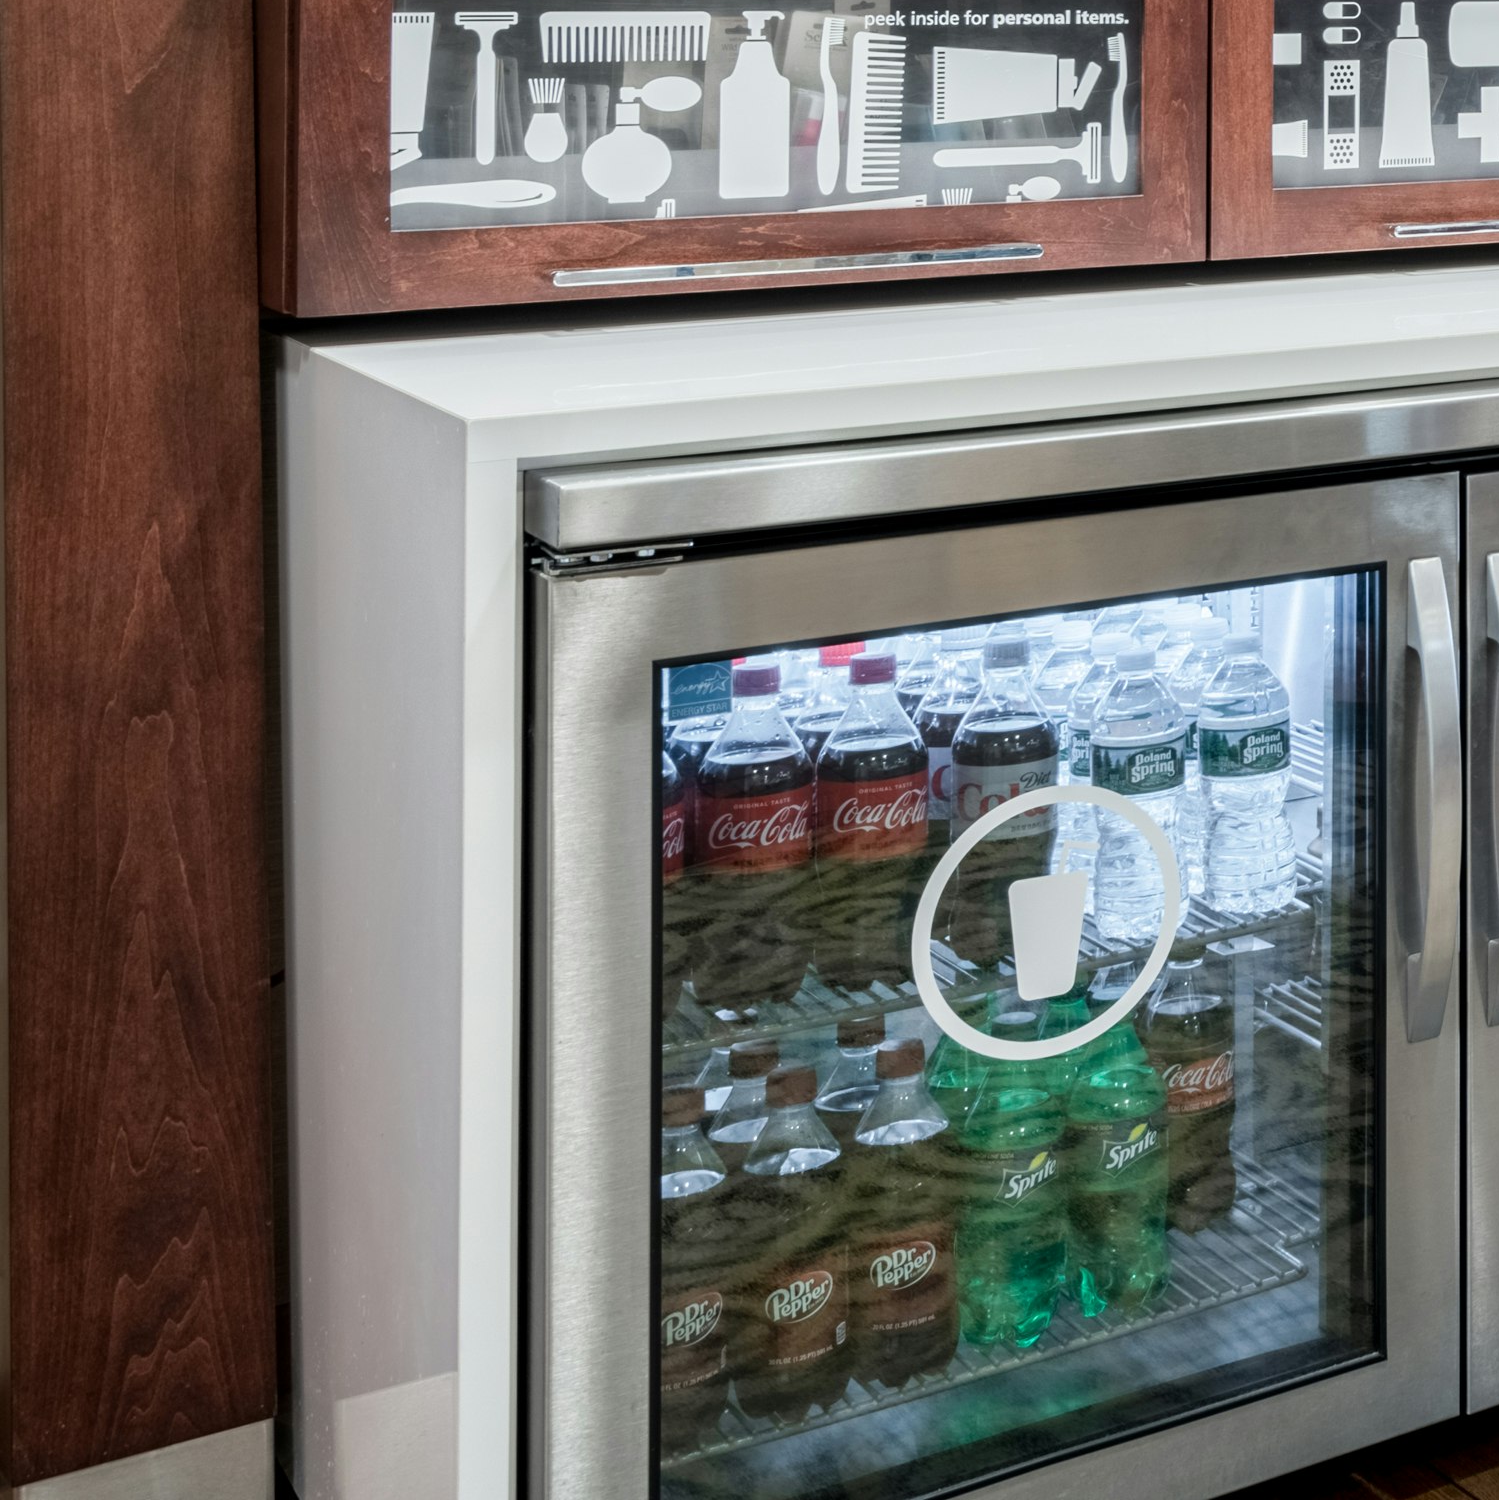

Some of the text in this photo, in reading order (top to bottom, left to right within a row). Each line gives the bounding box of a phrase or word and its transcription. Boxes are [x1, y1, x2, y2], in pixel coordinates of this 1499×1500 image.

[864, 9, 1130, 30] peek inside for personal items.
[671, 701, 729, 719] ENERGY STAR
[1243, 740, 1284, 765] Spring
[1247, 732, 1281, 748] Poland
[1131, 759, 1176, 784] Spring
[1135, 751, 1172, 767] Poland
[858, 781, 914, 795] ORIGINAL TASTE
[733, 796, 792, 811] ORIGINAL TASTE
[832, 784, 929, 834] Coca-Cola
[708, 800, 809, 851] Coca-Cola
[1105, 1128, 1158, 1170] Sprite
[1004, 1158, 1058, 1200] Sprite
[871, 1251, 933, 1289] Pepper
[892, 1248, 918, 1270] Dr
[788, 1276, 814, 1299] Dr
[683, 1297, 709, 1324] Dr
[769, 1279, 831, 1322] Pepper
[665, 1302, 721, 1346] Pepper
